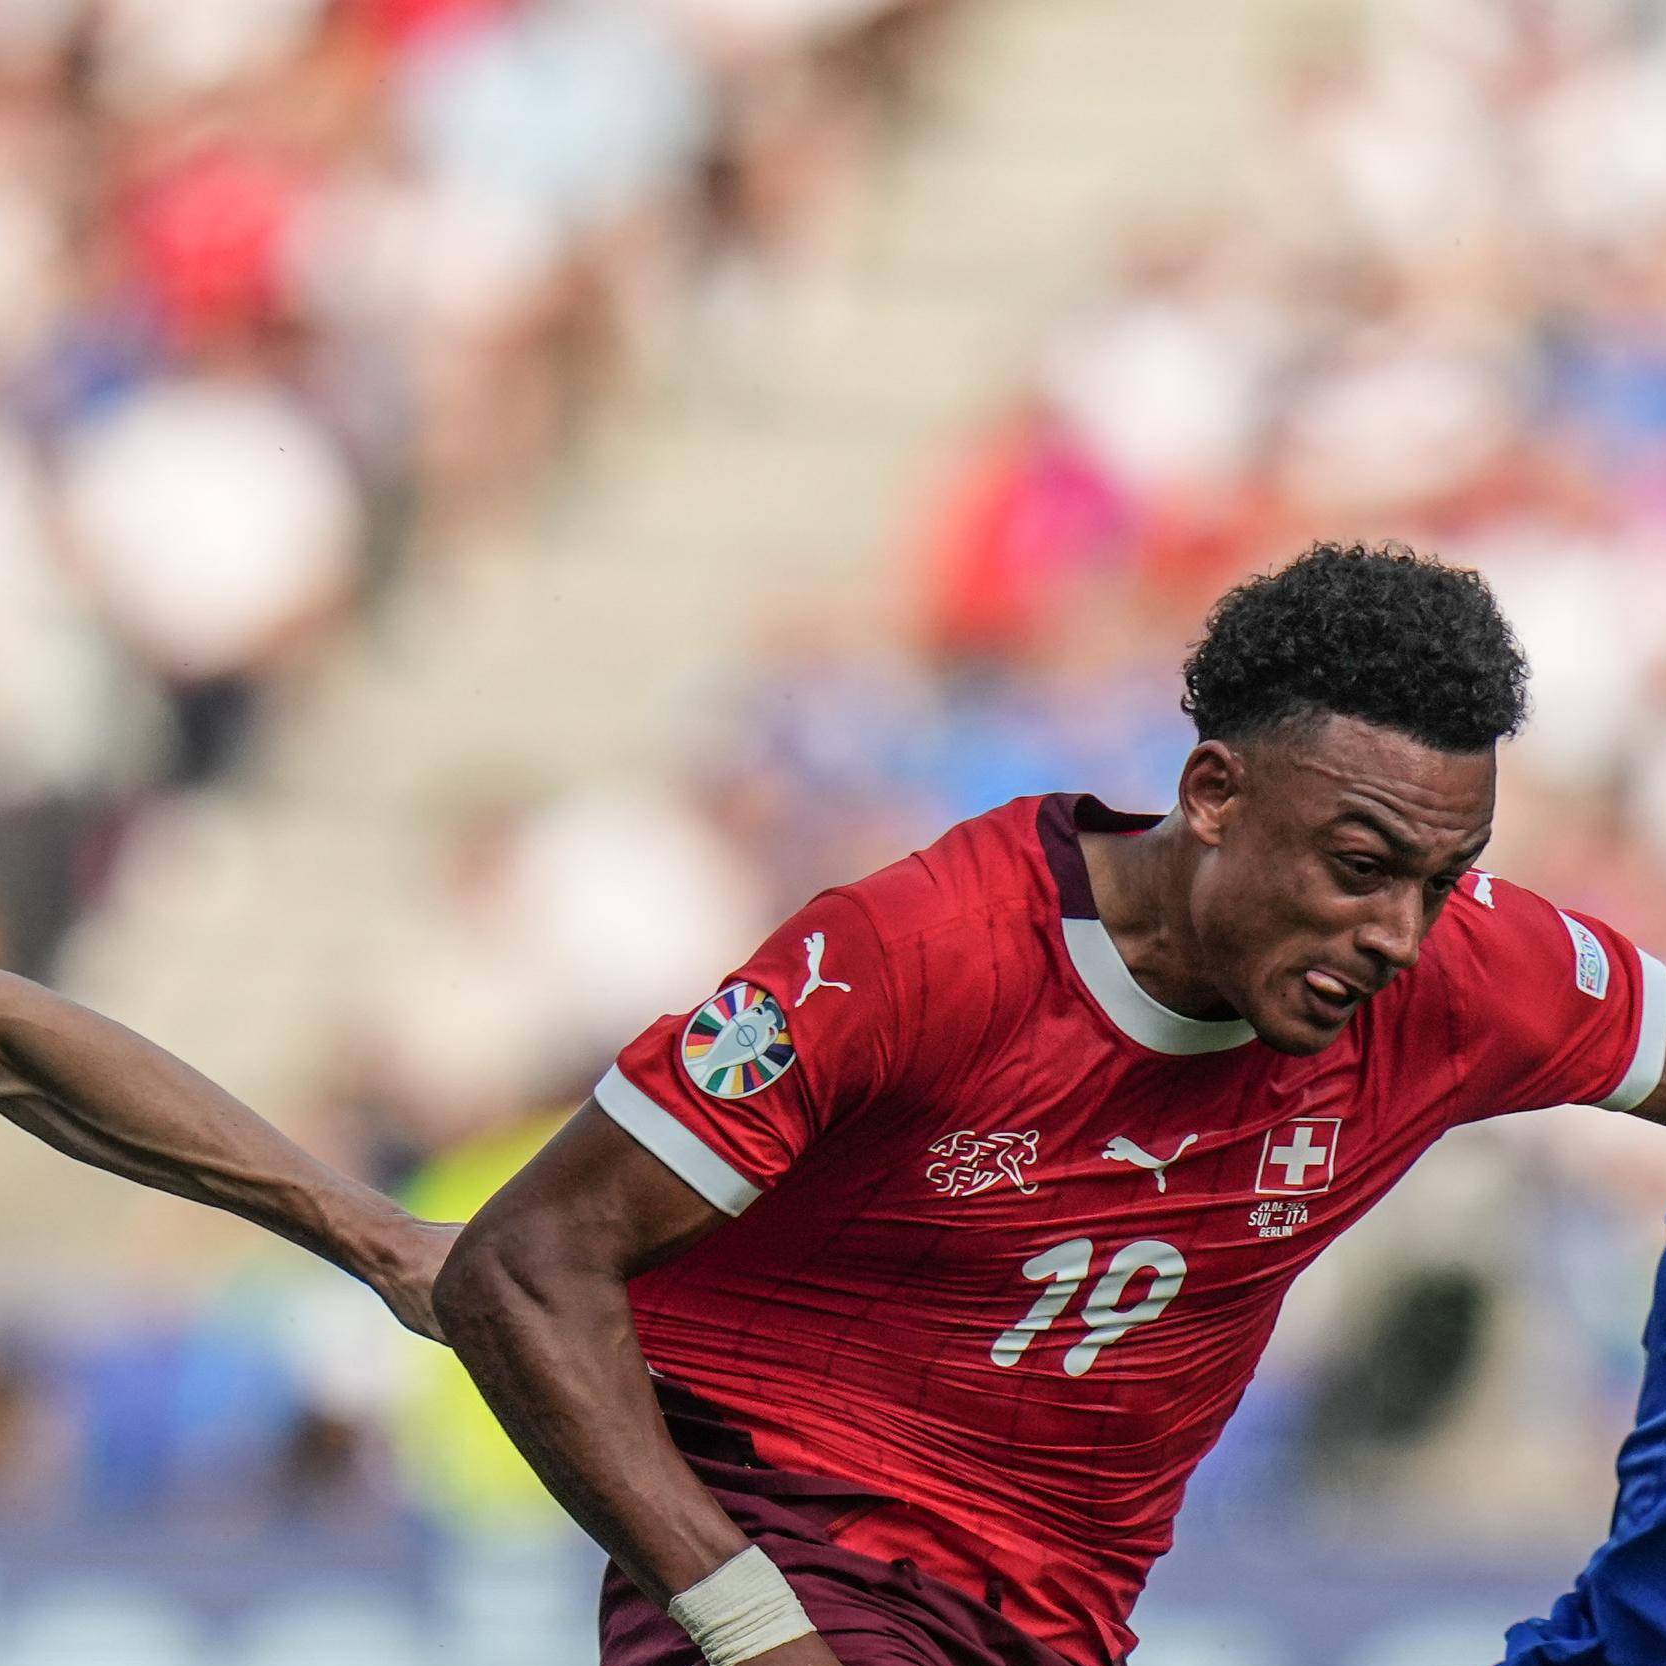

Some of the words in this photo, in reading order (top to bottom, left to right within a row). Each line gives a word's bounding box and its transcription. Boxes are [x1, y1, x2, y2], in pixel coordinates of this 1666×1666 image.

[1247, 1211, 1272, 1226] SUI
[1284, 1209, 1309, 1225] ITA
[1258, 1225, 1293, 1238] BERLIN
[989, 1236, 1188, 1377] 19
